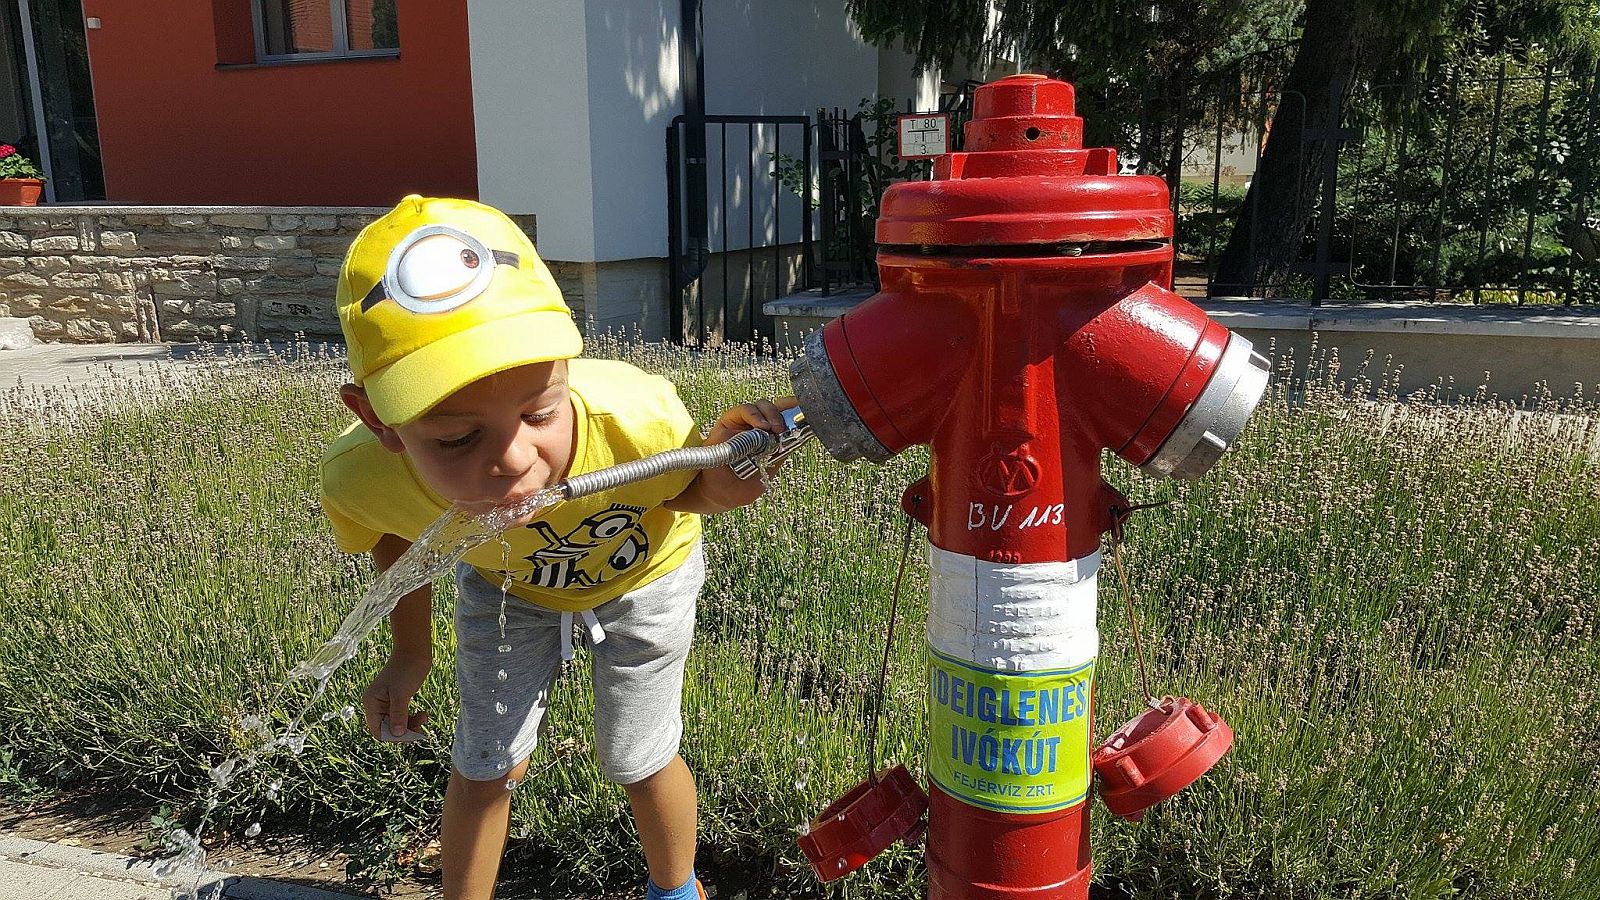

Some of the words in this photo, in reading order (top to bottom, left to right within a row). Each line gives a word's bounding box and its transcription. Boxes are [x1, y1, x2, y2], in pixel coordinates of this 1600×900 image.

[910, 119, 917, 129] T
[924, 118, 937, 129] 80
[1018, 503, 1065, 530] 113
[931, 666, 1088, 727] IDEIGLENES
[951, 724, 1061, 777] IVÓKÚT
[953, 770, 1023, 797] FEJÉRVÍZ
[1025, 784, 1055, 798] ZRT.
